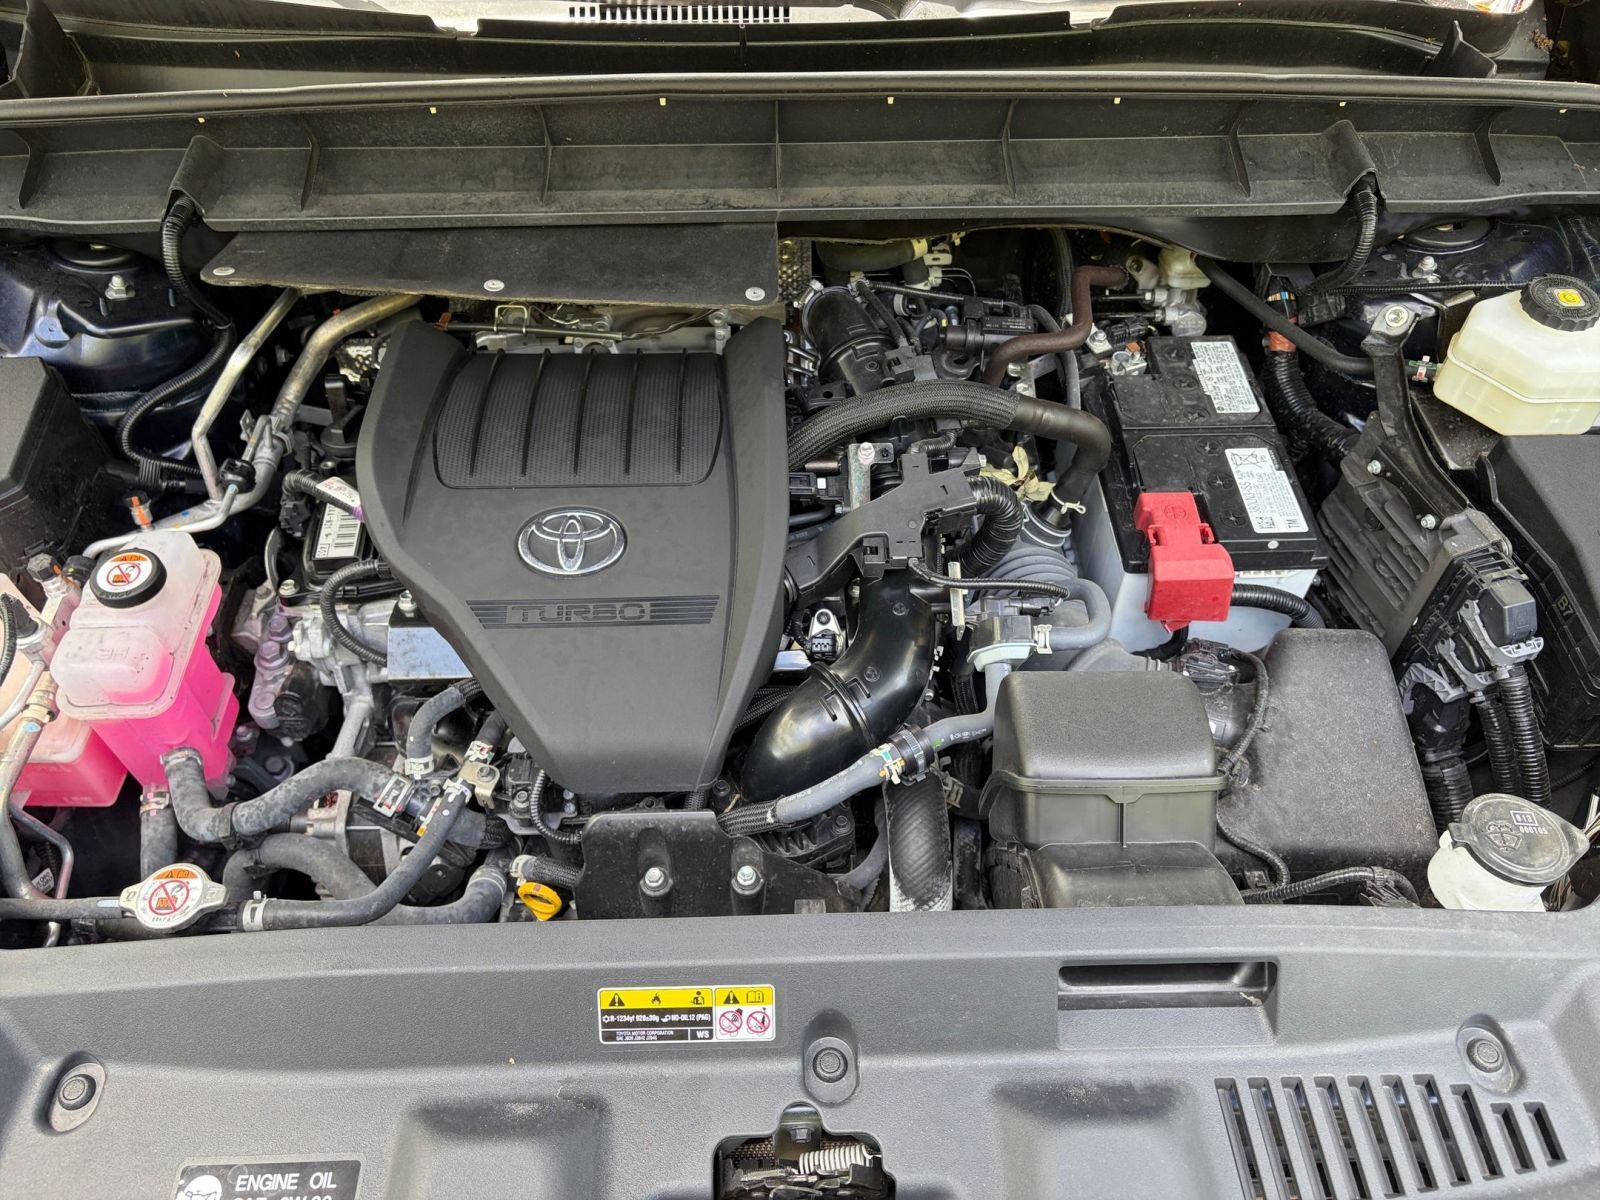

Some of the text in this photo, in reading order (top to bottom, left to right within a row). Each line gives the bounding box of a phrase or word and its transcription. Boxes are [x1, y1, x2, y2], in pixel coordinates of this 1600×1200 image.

[511, 602, 647, 623] TURBO
[696, 1030, 710, 1039] WS
[235, 1172, 336, 1191] ENGINE OIL
